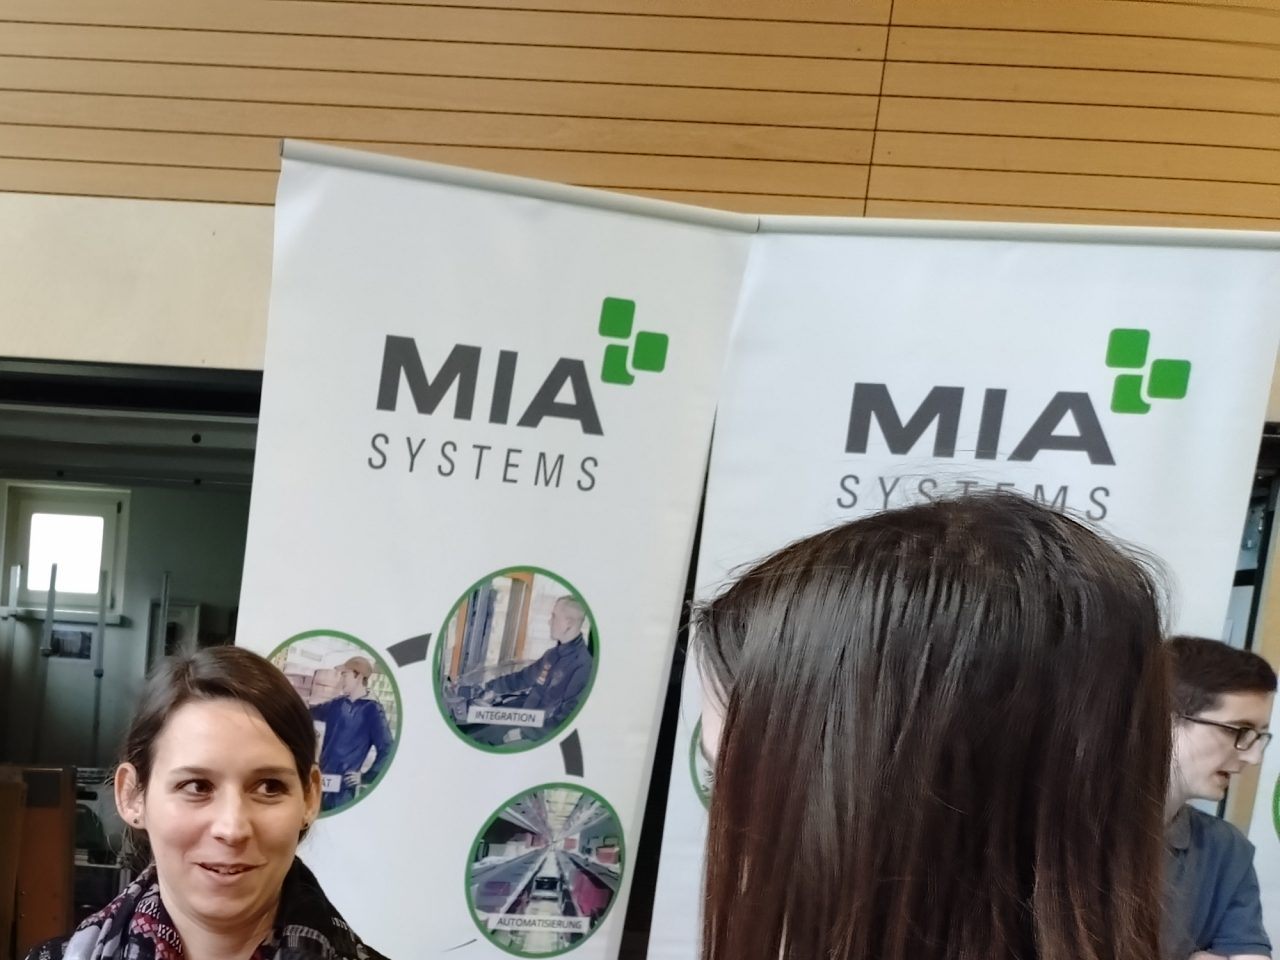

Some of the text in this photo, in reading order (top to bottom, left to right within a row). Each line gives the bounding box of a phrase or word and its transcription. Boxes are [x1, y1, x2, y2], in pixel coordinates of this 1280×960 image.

[376, 334, 604, 436] MIA
[845, 382, 1116, 466] MIA
[368, 433, 598, 491] SYSTEMS
[475, 711, 536, 722] INTEGRATION
[497, 918, 582, 929] AUTOMATISIERUNG
